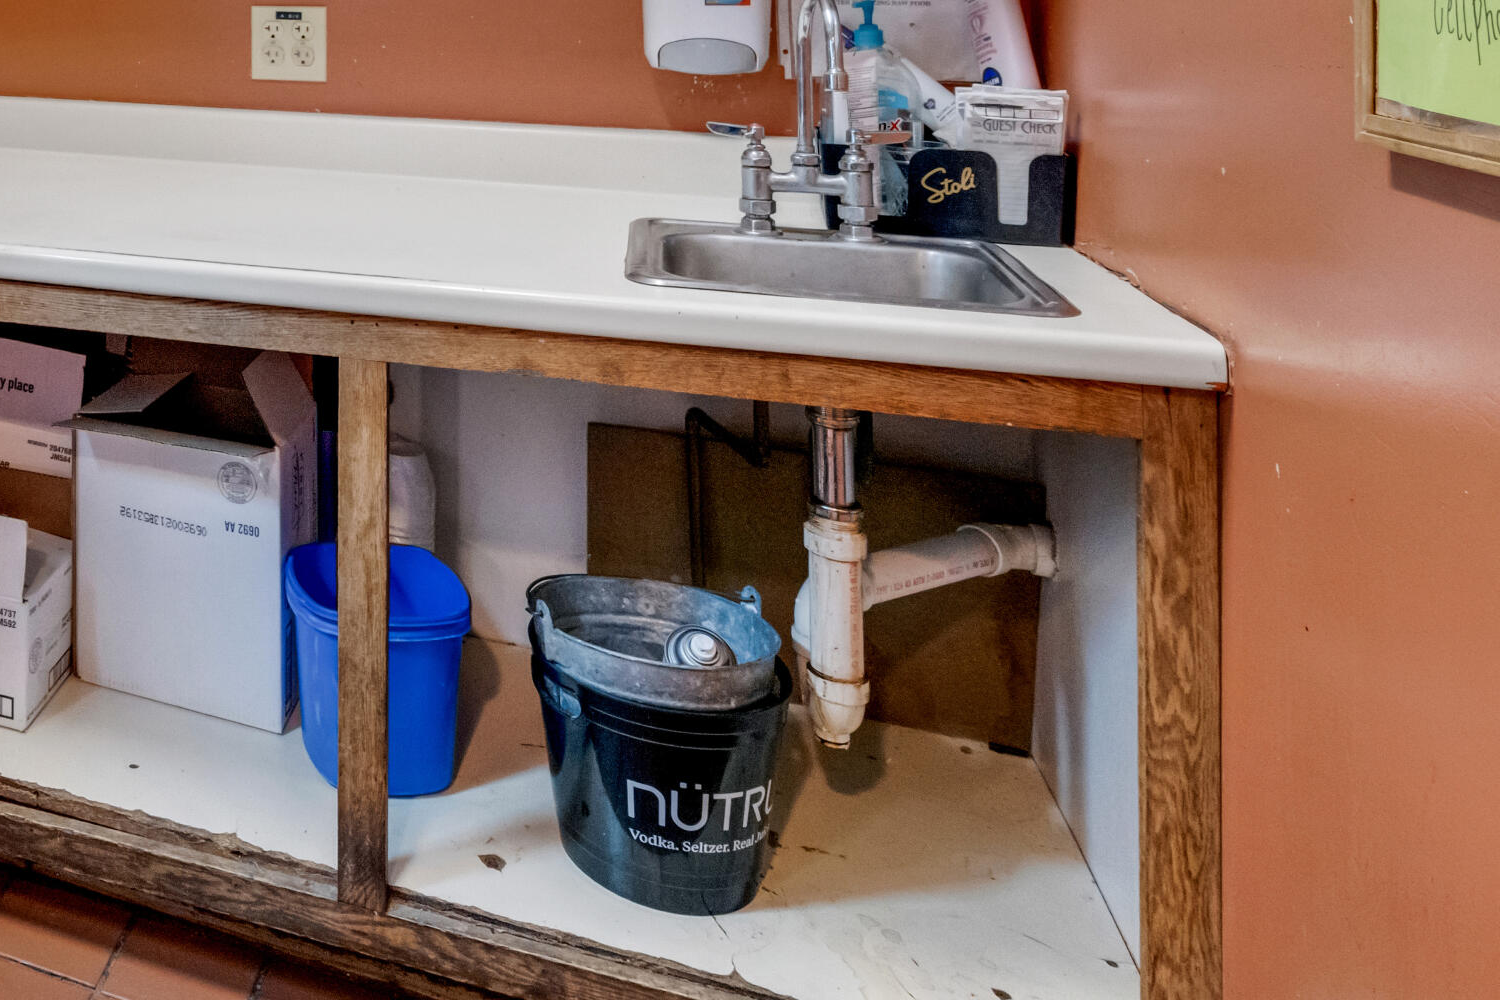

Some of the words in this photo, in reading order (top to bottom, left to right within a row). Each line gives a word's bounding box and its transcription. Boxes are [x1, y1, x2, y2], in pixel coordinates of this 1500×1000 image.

[983, 118, 1017, 132] GUEST
[1021, 120, 1057, 134] CHECK
[921, 166, 976, 204] Stoli
[8, 377, 35, 393] place
[224, 520, 236, 533] AA
[238, 523, 260, 538] 0692
[628, 826, 679, 851] Vodka.
[682, 839, 731, 854] Seltzer.
[733, 833, 754, 851] Real
